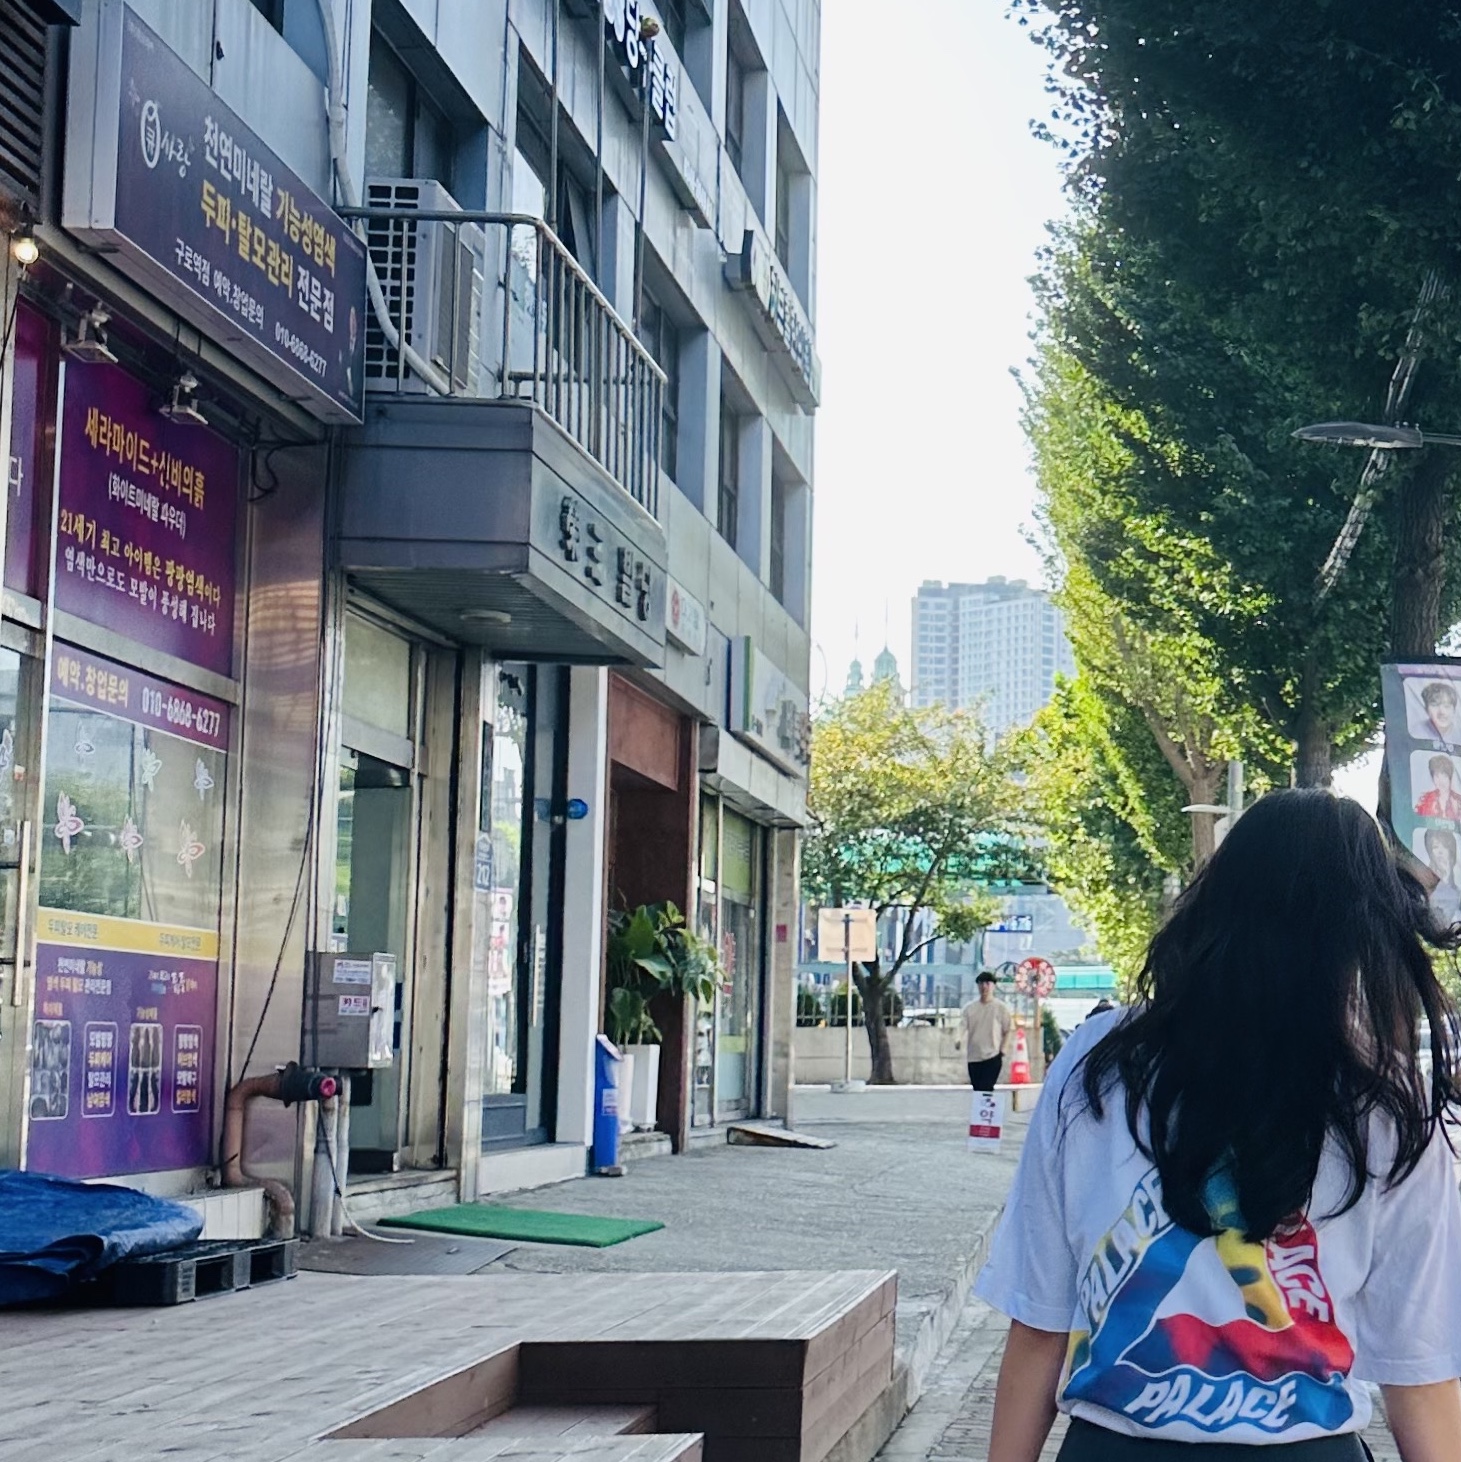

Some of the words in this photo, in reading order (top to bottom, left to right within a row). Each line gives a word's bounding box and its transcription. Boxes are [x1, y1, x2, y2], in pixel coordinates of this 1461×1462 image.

[203, 115, 273, 219] 천연미네랄
[276, 187, 337, 278] 기능성염색
[174, 237, 210, 287] 구로역점
[296, 264, 335, 334] 전문점
[60, 508, 97, 550] 21세기
[100, 529, 121, 558] 최고
[123, 541, 163, 580] 아이템은
[64, 546, 126, 593] 염색만으로도
[127, 577, 158, 611] 모발이
[141, 686, 221, 738] 010-6868-6277
[1122, 1373, 1297, 1428] PALACE
